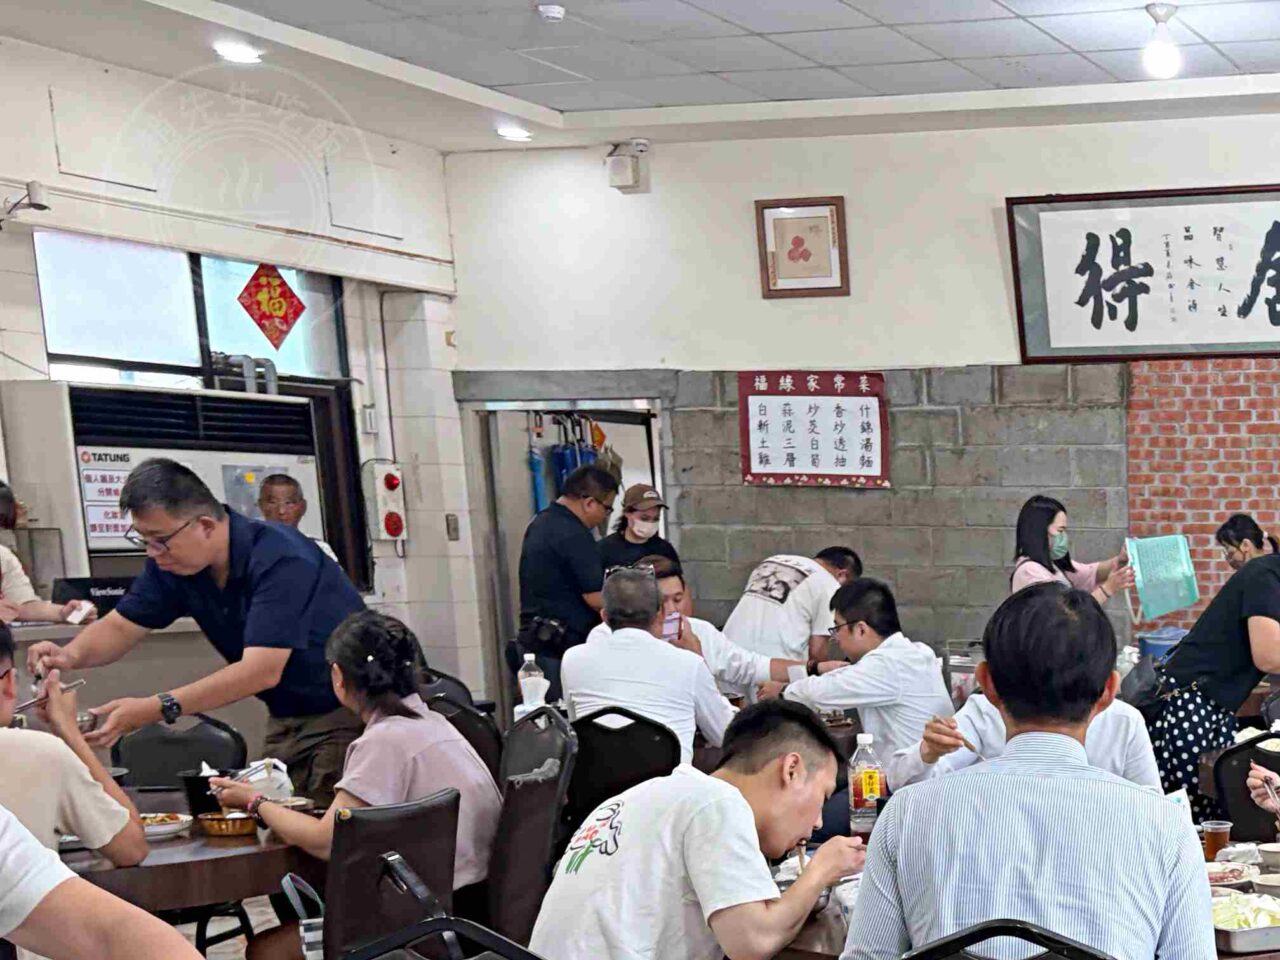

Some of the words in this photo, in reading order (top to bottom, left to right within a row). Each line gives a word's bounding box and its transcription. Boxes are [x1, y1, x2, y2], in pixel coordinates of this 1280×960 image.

[256, 275, 286, 317] 福
[753, 373, 872, 393] 福緣家常菜
[91, 452, 130, 462] TATUNG
